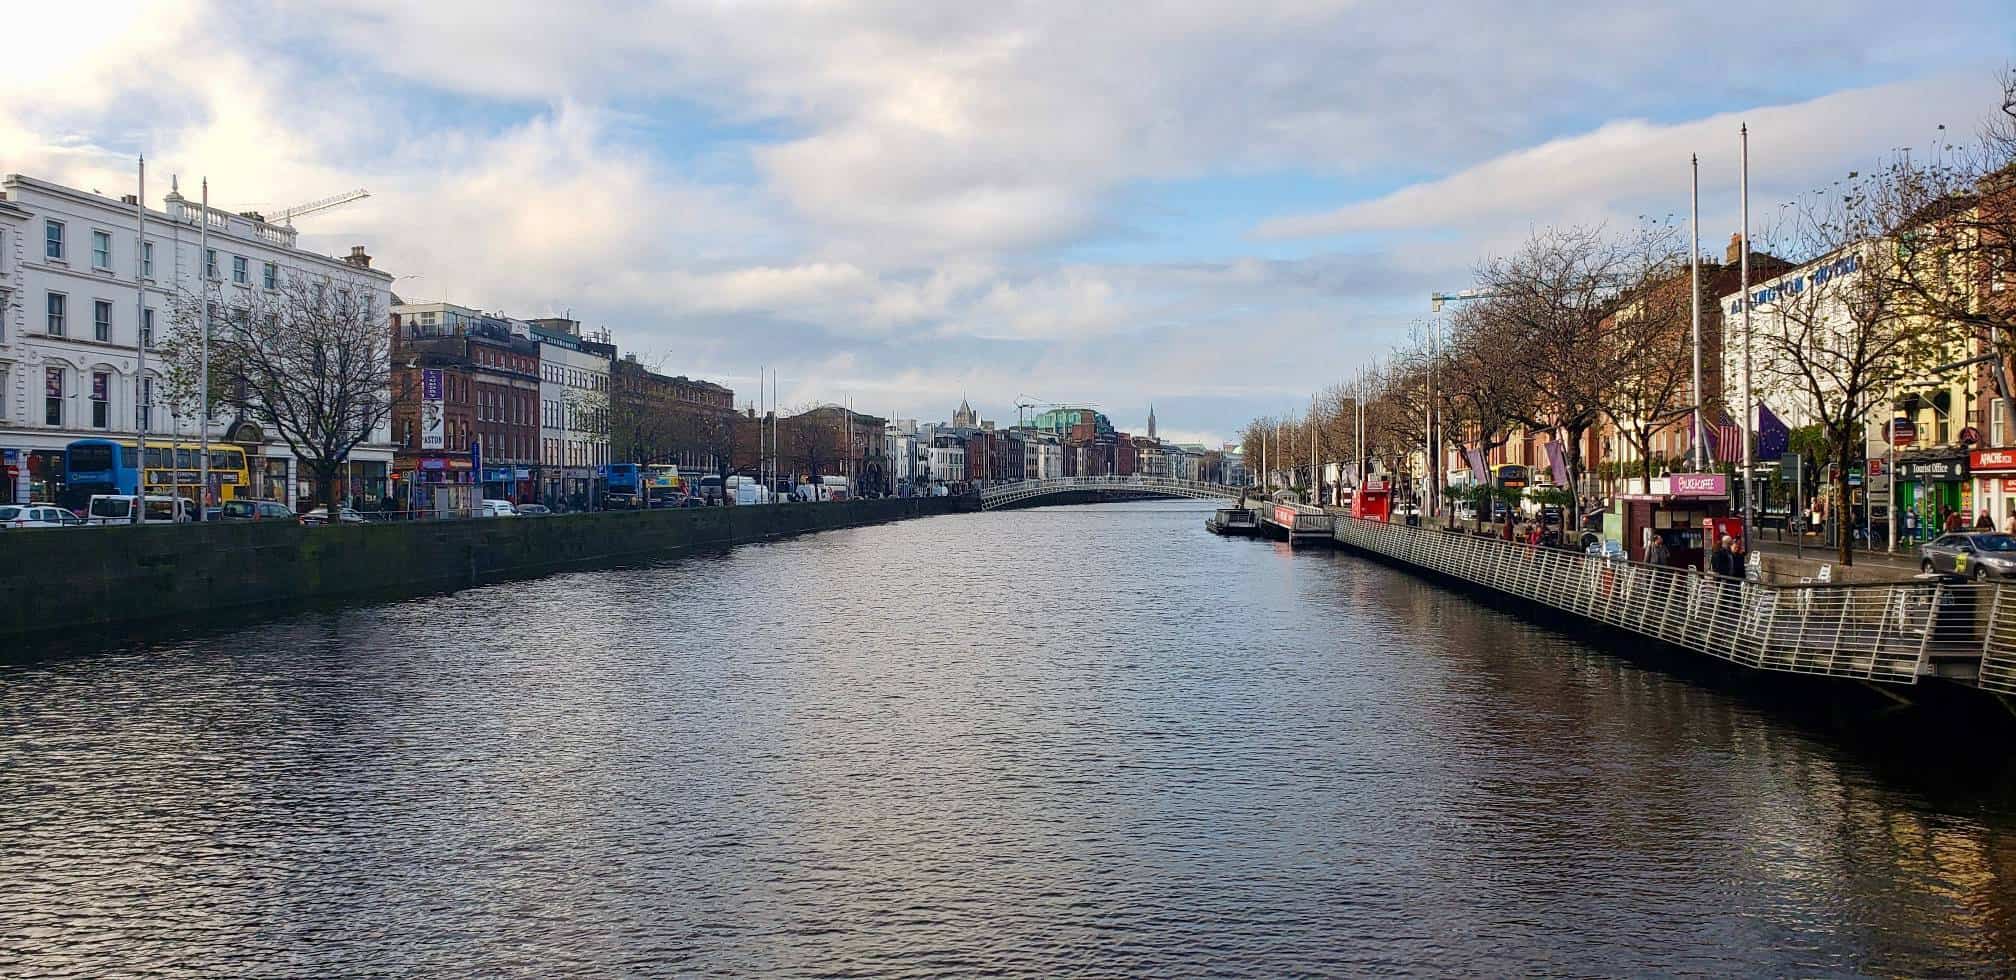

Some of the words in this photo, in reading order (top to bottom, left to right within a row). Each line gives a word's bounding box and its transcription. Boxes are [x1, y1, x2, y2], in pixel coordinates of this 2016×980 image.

[1731, 275, 1804, 315] AINGTON
[1912, 463, 1931, 473] Tourist
[1931, 462, 1948, 473] Office
